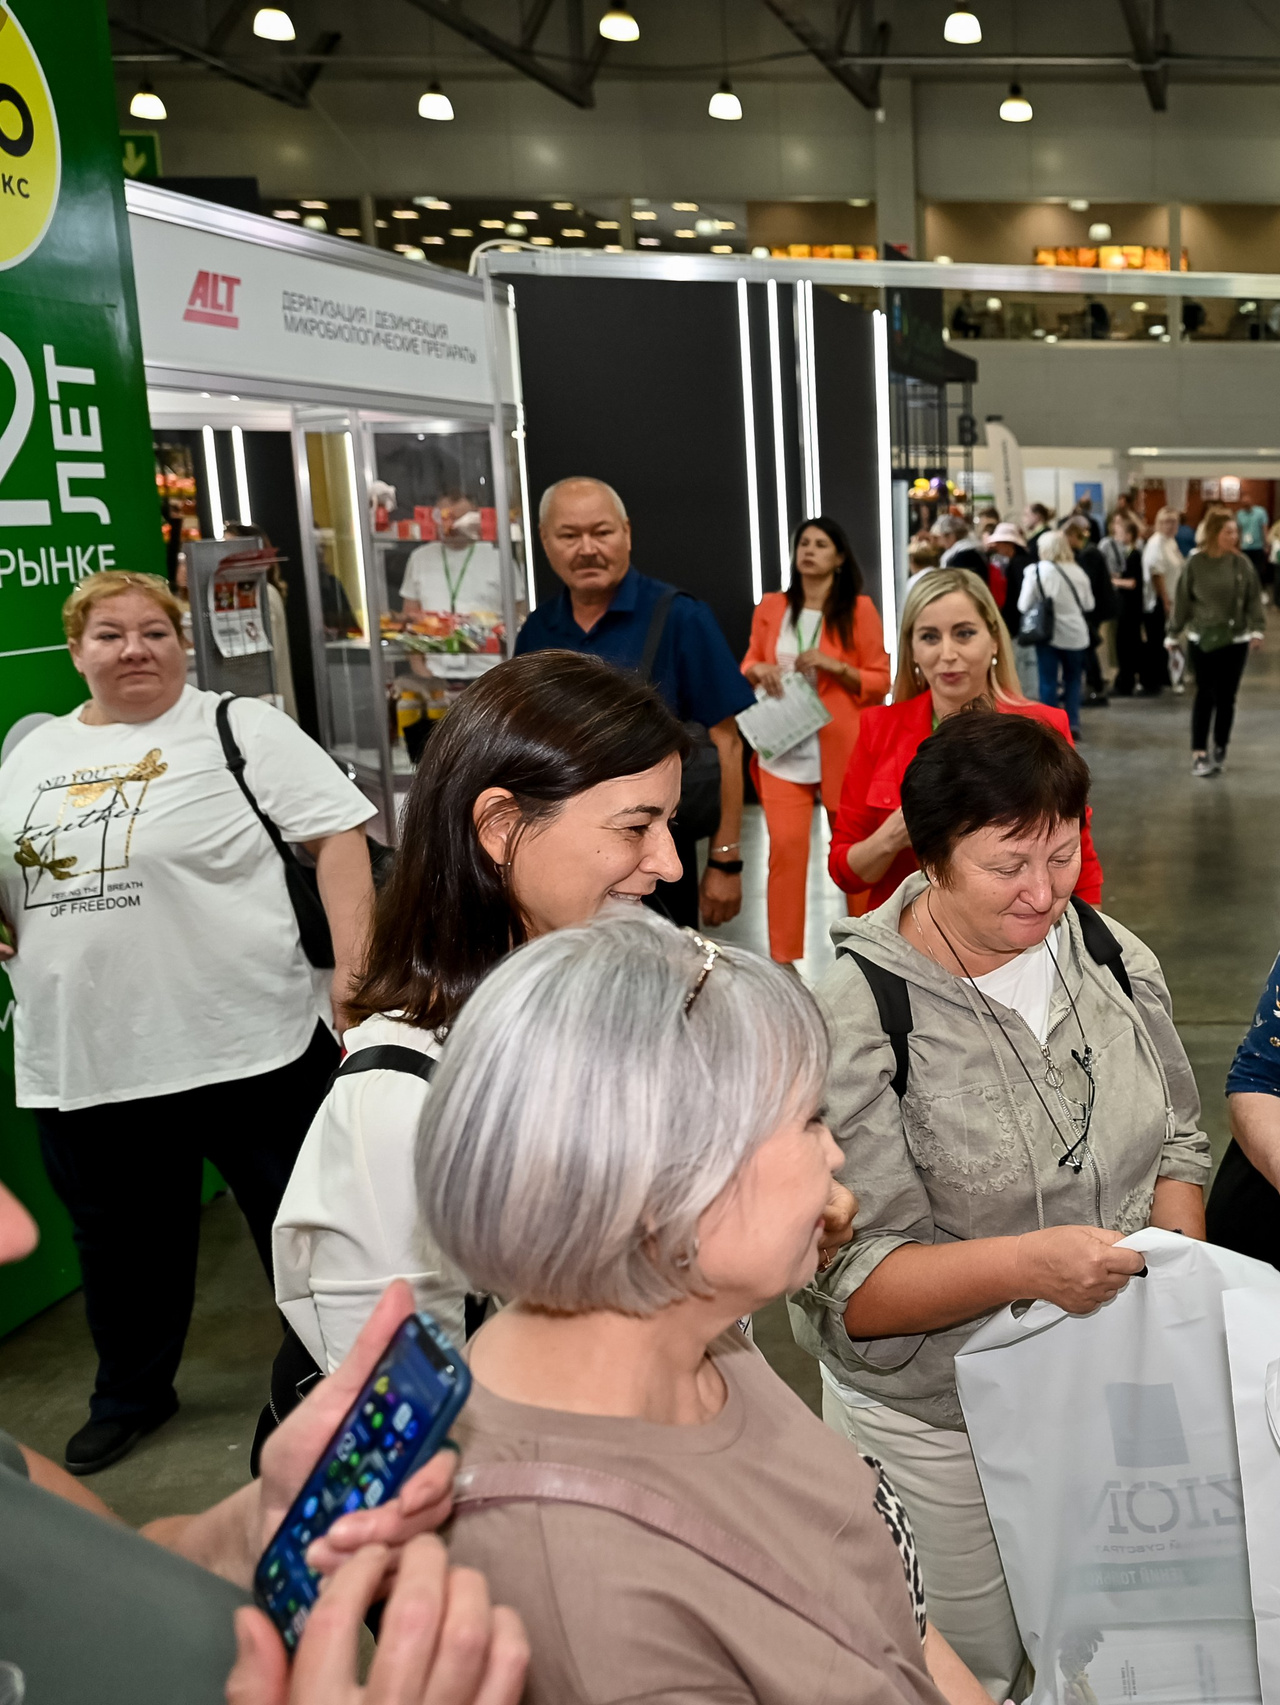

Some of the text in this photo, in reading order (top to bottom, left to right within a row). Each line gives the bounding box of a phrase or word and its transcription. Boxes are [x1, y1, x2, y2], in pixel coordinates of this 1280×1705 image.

[188, 269, 242, 313] ALT
[282, 290, 449, 339] ДЕРАТИЗАЦИЯ ДЕЗИНСЕКЦИЯ
[283, 313, 478, 365] МИКРОБИОЛОГИЧЕСКИЕ ПРЕПАРАТЫ
[43, 344, 111, 525] ЛЕТ
[0, 544, 116, 589] РЫНКЕ
[51, 895, 141, 917] OF FREEDOM
[107, 881, 144, 893] BREATH
